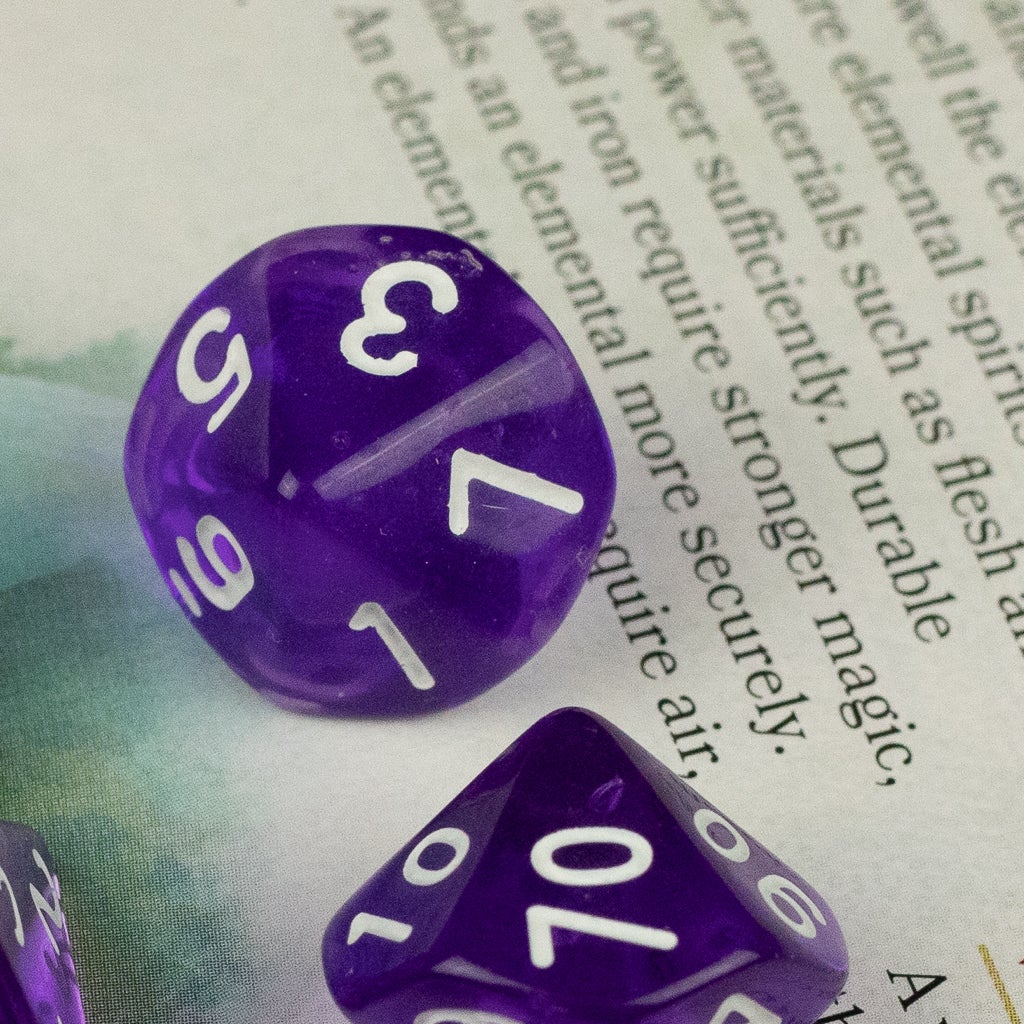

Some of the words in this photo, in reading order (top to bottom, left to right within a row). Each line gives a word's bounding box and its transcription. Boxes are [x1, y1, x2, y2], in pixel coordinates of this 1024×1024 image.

[828, 51, 986, 279] elemental
[939, 86, 1006, 164] the
[175, 306, 252, 434] 5
[340, 260, 459, 377] 3
[606, 8, 718, 143] power
[693, 153, 850, 425] sufficiently.
[829, 428, 957, 644] Durable
[726, 36, 867, 253] materials
[840, 260, 931, 377] such
[900, 388, 955, 446] as
[933, 454, 1024, 579] flesh
[332, 3, 395, 66] An
[372, 70, 506, 262] element
[589, 519, 678, 680] quire
[657, 694, 723, 780] air,
[466, 73, 522, 132] an
[499, 140, 653, 370] elemental
[613, 379, 700, 514] more
[680, 523, 810, 756] securely.
[525, 5, 609, 87] and
[570, 90, 643, 190] iron
[621, 198, 731, 374] require
[710, 383, 838, 595] stronger
[813, 610, 917, 787] magic,
[447, 447, 584, 535] 7
[348, 601, 436, 690] 1
[346, 827, 470, 945] 10
[526, 826, 678, 969] 70
[885, 969, 948, 1013] A
